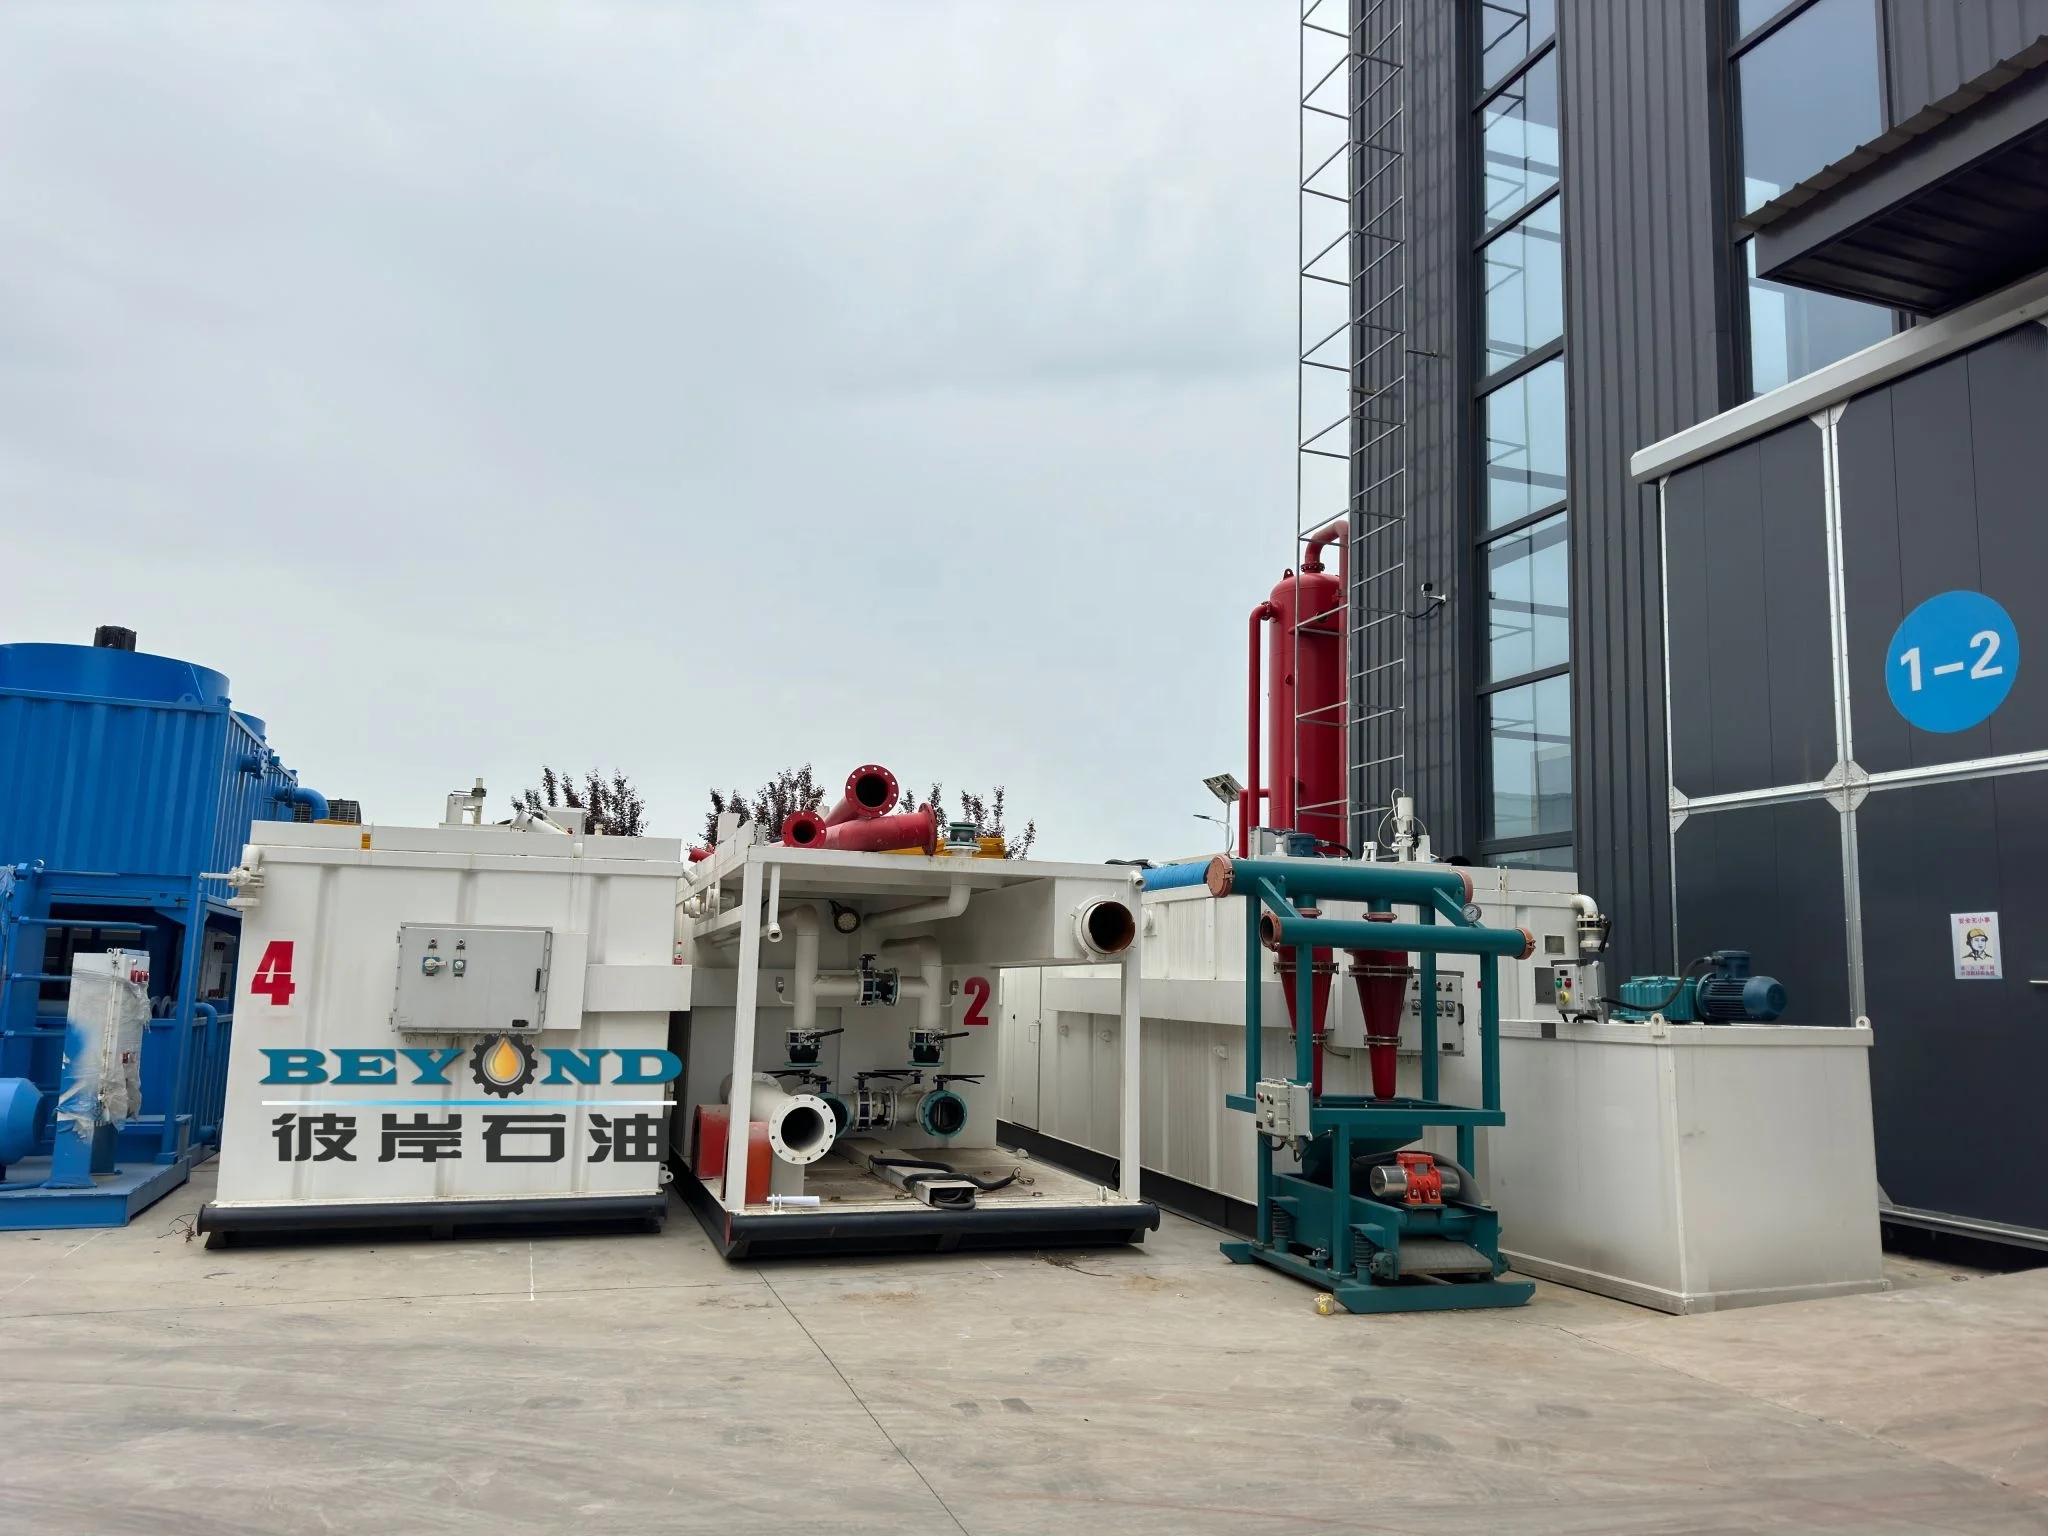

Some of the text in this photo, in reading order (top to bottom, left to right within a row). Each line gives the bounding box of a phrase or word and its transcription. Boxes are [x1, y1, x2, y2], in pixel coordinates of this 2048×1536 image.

[1900, 630, 2003, 692] 1-2
[250, 941, 296, 1006] 4
[963, 977, 991, 1026] 2
